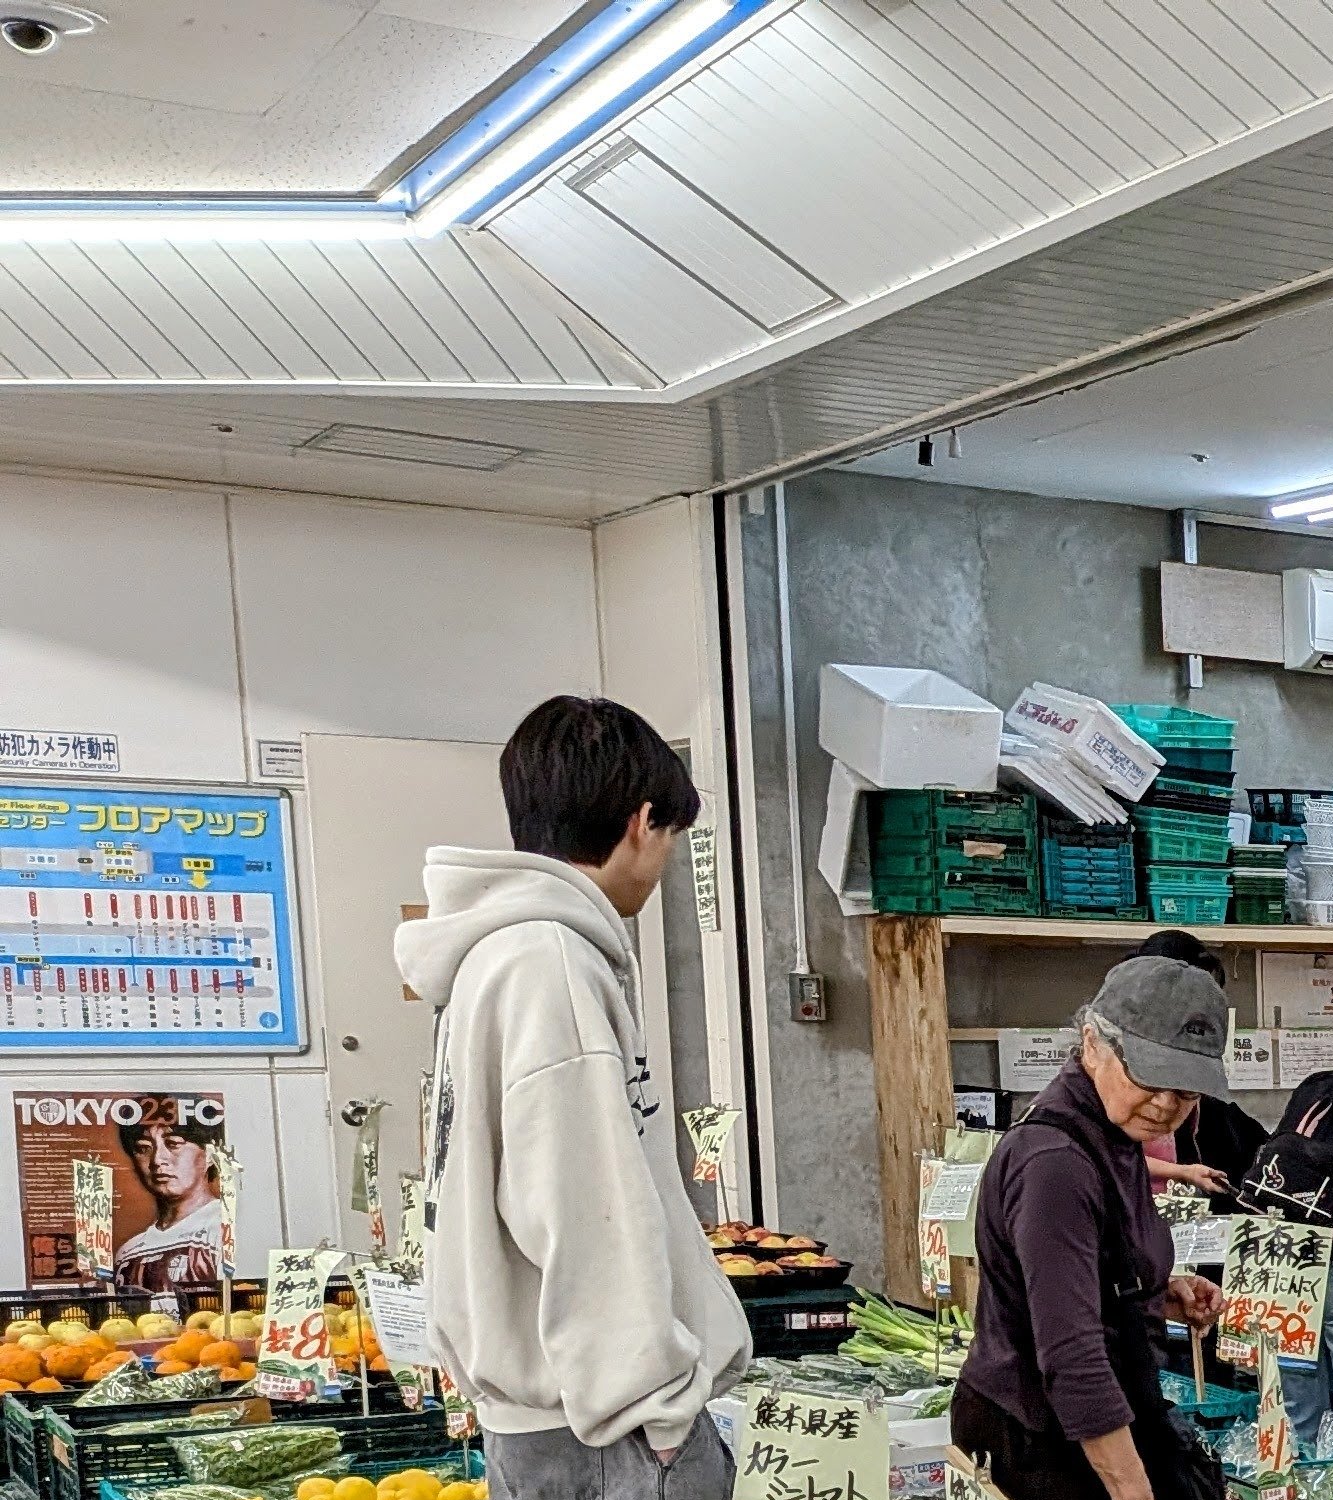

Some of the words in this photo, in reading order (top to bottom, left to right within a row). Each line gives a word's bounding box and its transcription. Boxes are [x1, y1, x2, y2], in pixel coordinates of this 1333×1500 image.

[76, 805, 268, 837] フロアマップ
[1229, 1218, 1332, 1269] 青森産
[748, 1396, 862, 1441] 熊本県産
[744, 1441, 819, 1476] カラー
